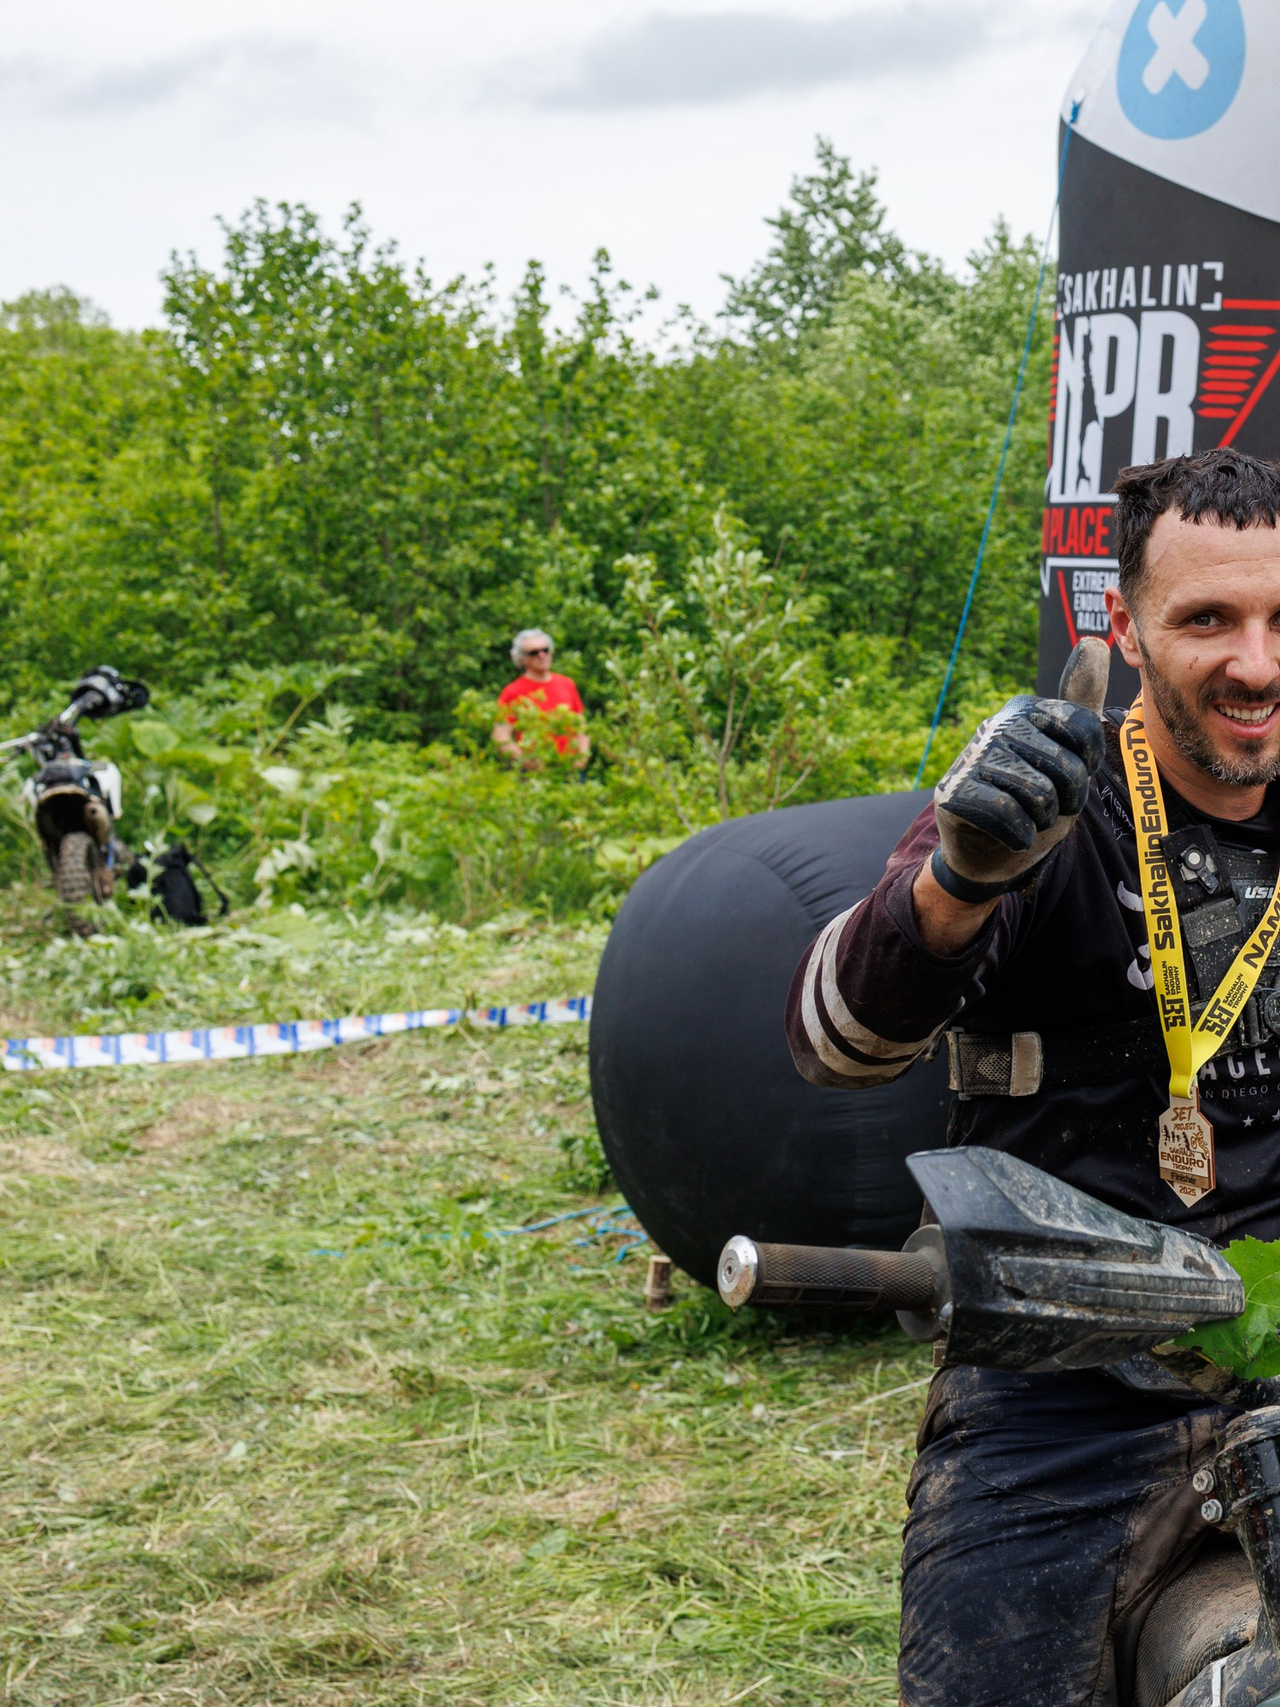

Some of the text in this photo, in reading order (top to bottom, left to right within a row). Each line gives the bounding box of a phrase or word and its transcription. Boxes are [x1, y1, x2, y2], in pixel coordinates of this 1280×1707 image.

[1050, 506, 1112, 556] PLACE
[1073, 570, 1119, 592] EXTREM
[1074, 592, 1106, 612] ENDU
[1076, 611, 1109, 631] RALLY
[1161, 960, 1171, 996] SAKHALIN
[1167, 965, 1176, 996] ENDURO
[1173, 965, 1181, 995] TROPHY
[1222, 972, 1244, 1004] SAKHALIN
[1227, 980, 1245, 1007] ENDURO
[1231, 983, 1249, 1009] TROPHY
[1221, 1084, 1269, 1100] DIEGO
[1171, 1105, 1195, 1122] SET
[1173, 1122, 1196, 1134] PROJECT
[1160, 1151, 1205, 1169] ENDURO
[1172, 1162, 1194, 1173] TROPHY
[1171, 1172, 1197, 1185] Finisher
[1178, 1185, 1197, 1197] 2025
